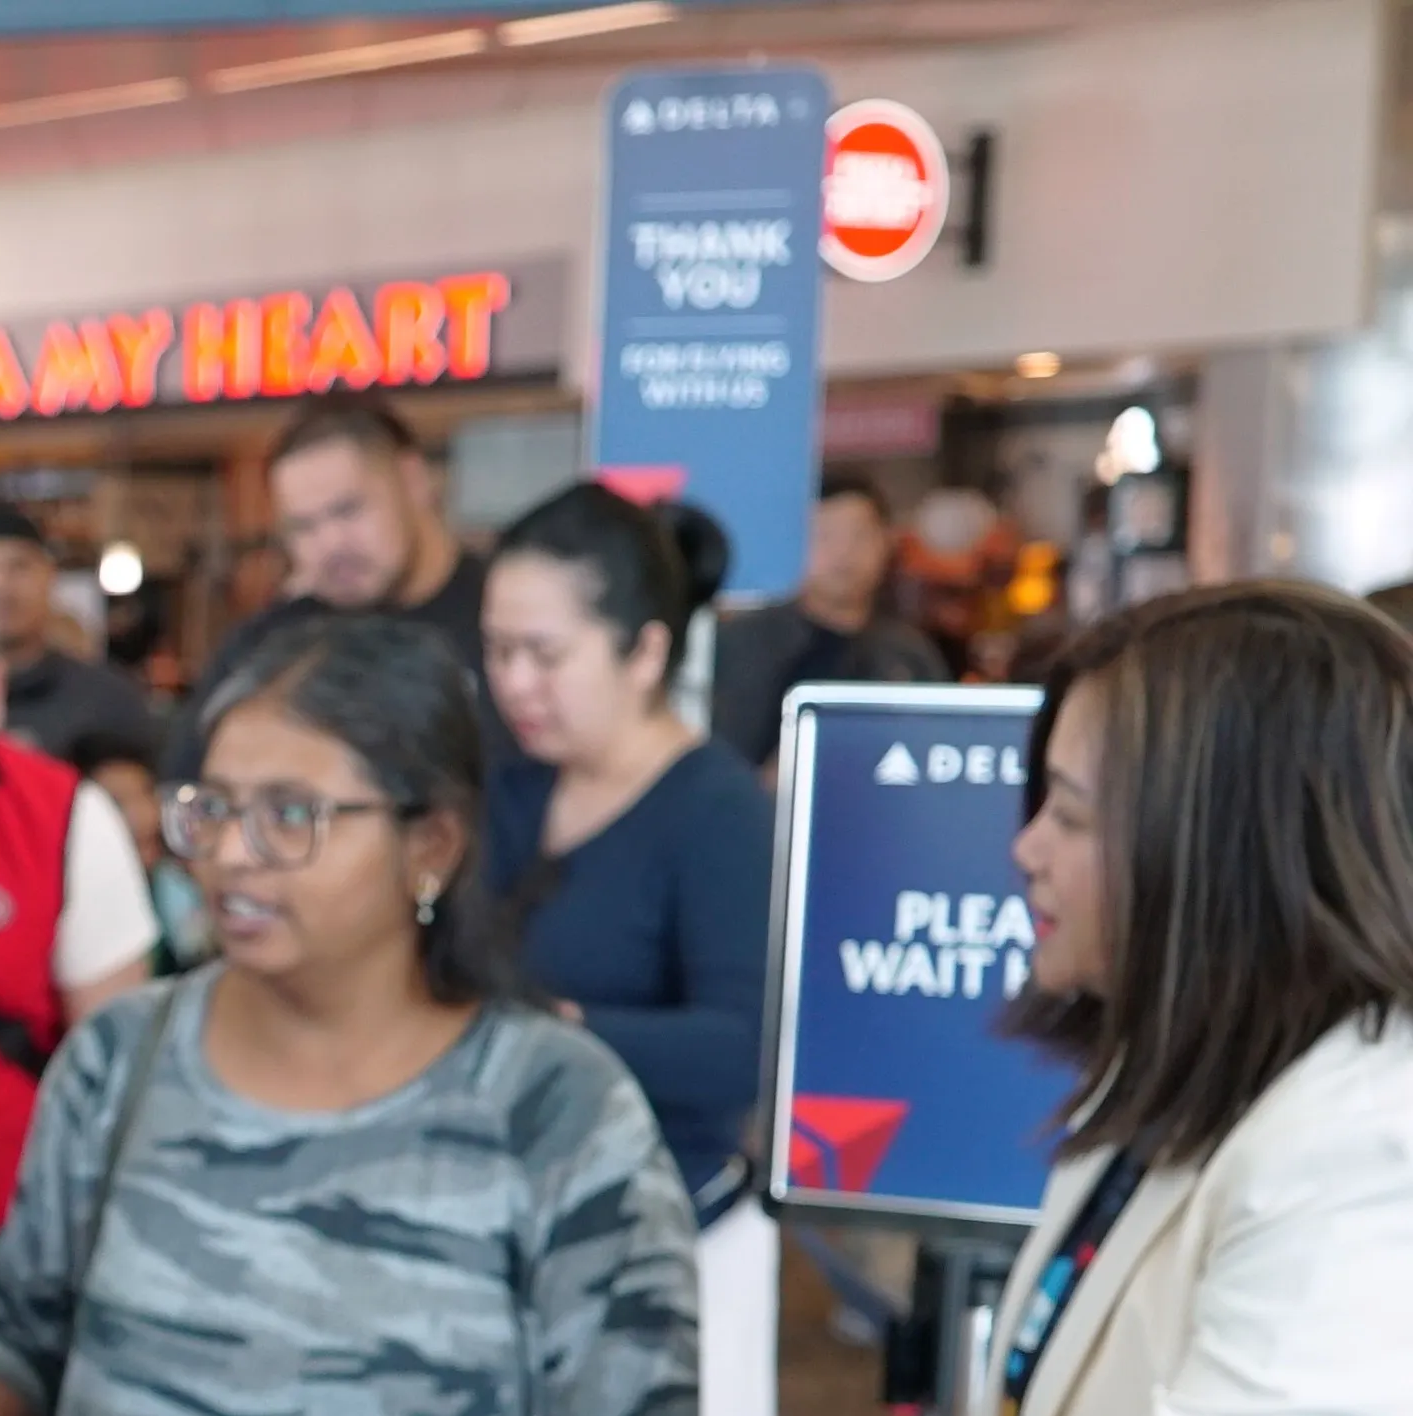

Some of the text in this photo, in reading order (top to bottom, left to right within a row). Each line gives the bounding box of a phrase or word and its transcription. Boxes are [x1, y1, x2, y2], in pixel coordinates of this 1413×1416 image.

[657, 93, 780, 131] DELTA
[629, 219, 792, 268] THANK
[657, 260, 763, 310] YOU
[31, 307, 173, 417] MY
[181, 272, 510, 402] HEART
[926, 744, 1028, 785] DEL
[894, 889, 1035, 948] PLEA
[839, 938, 996, 999] WAIT
